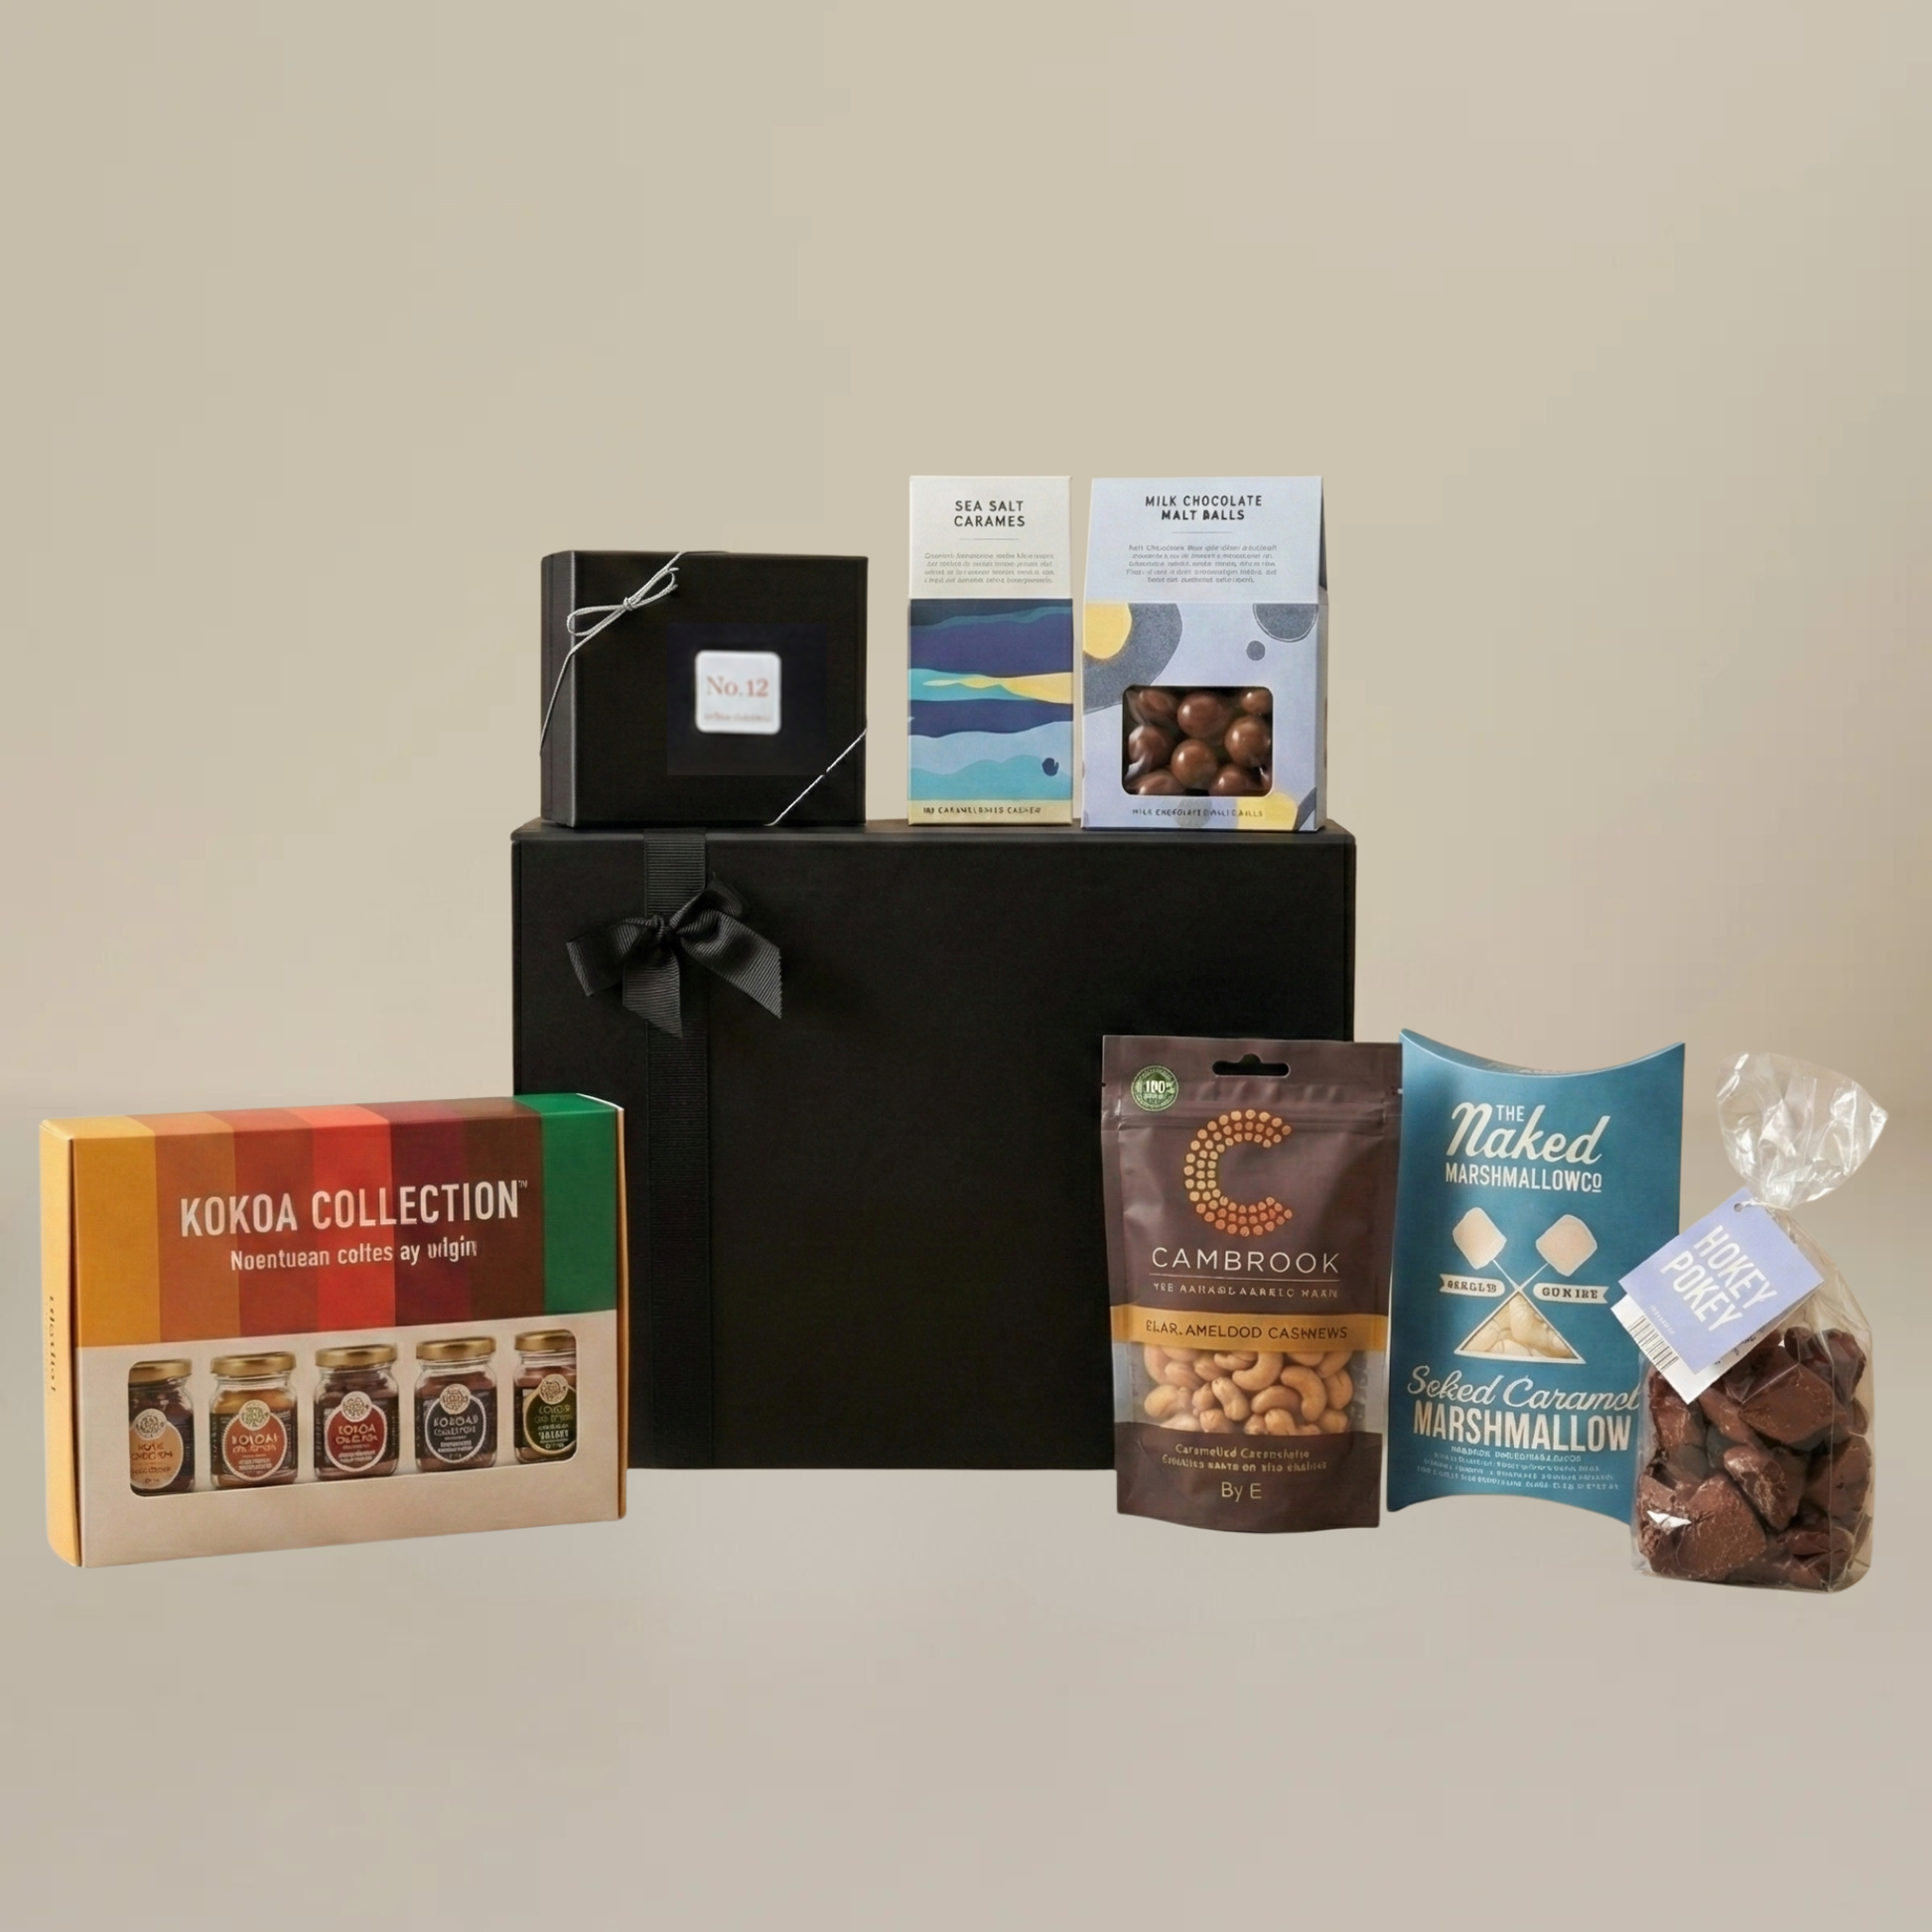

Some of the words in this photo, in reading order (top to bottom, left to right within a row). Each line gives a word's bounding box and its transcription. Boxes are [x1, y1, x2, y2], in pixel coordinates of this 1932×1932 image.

[955, 500, 983, 511] SEA
[989, 500, 1024, 512] SALT
[1145, 495, 1177, 506] MILK
[1182, 495, 1263, 506] CHOCOLATE
[954, 515, 1026, 527] CARAMES
[1162, 509, 1197, 520] MALT
[1496, 1104, 1525, 1122] THE
[1447, 1102, 1611, 1165] Naked
[181, 1192, 298, 1237] KOKOA
[400, 1243, 420, 1265] ay
[1152, 1247, 1339, 1274] CAMBROOK
[1694, 1225, 1777, 1310] HOKEY
[1660, 1251, 1742, 1331] POKEY
[1502, 1375, 1640, 1411] Caramel
[1414, 1400, 1631, 1451] MARSHMALLOW
[1221, 1481, 1243, 1502] By
[1250, 1482, 1262, 1499] E
